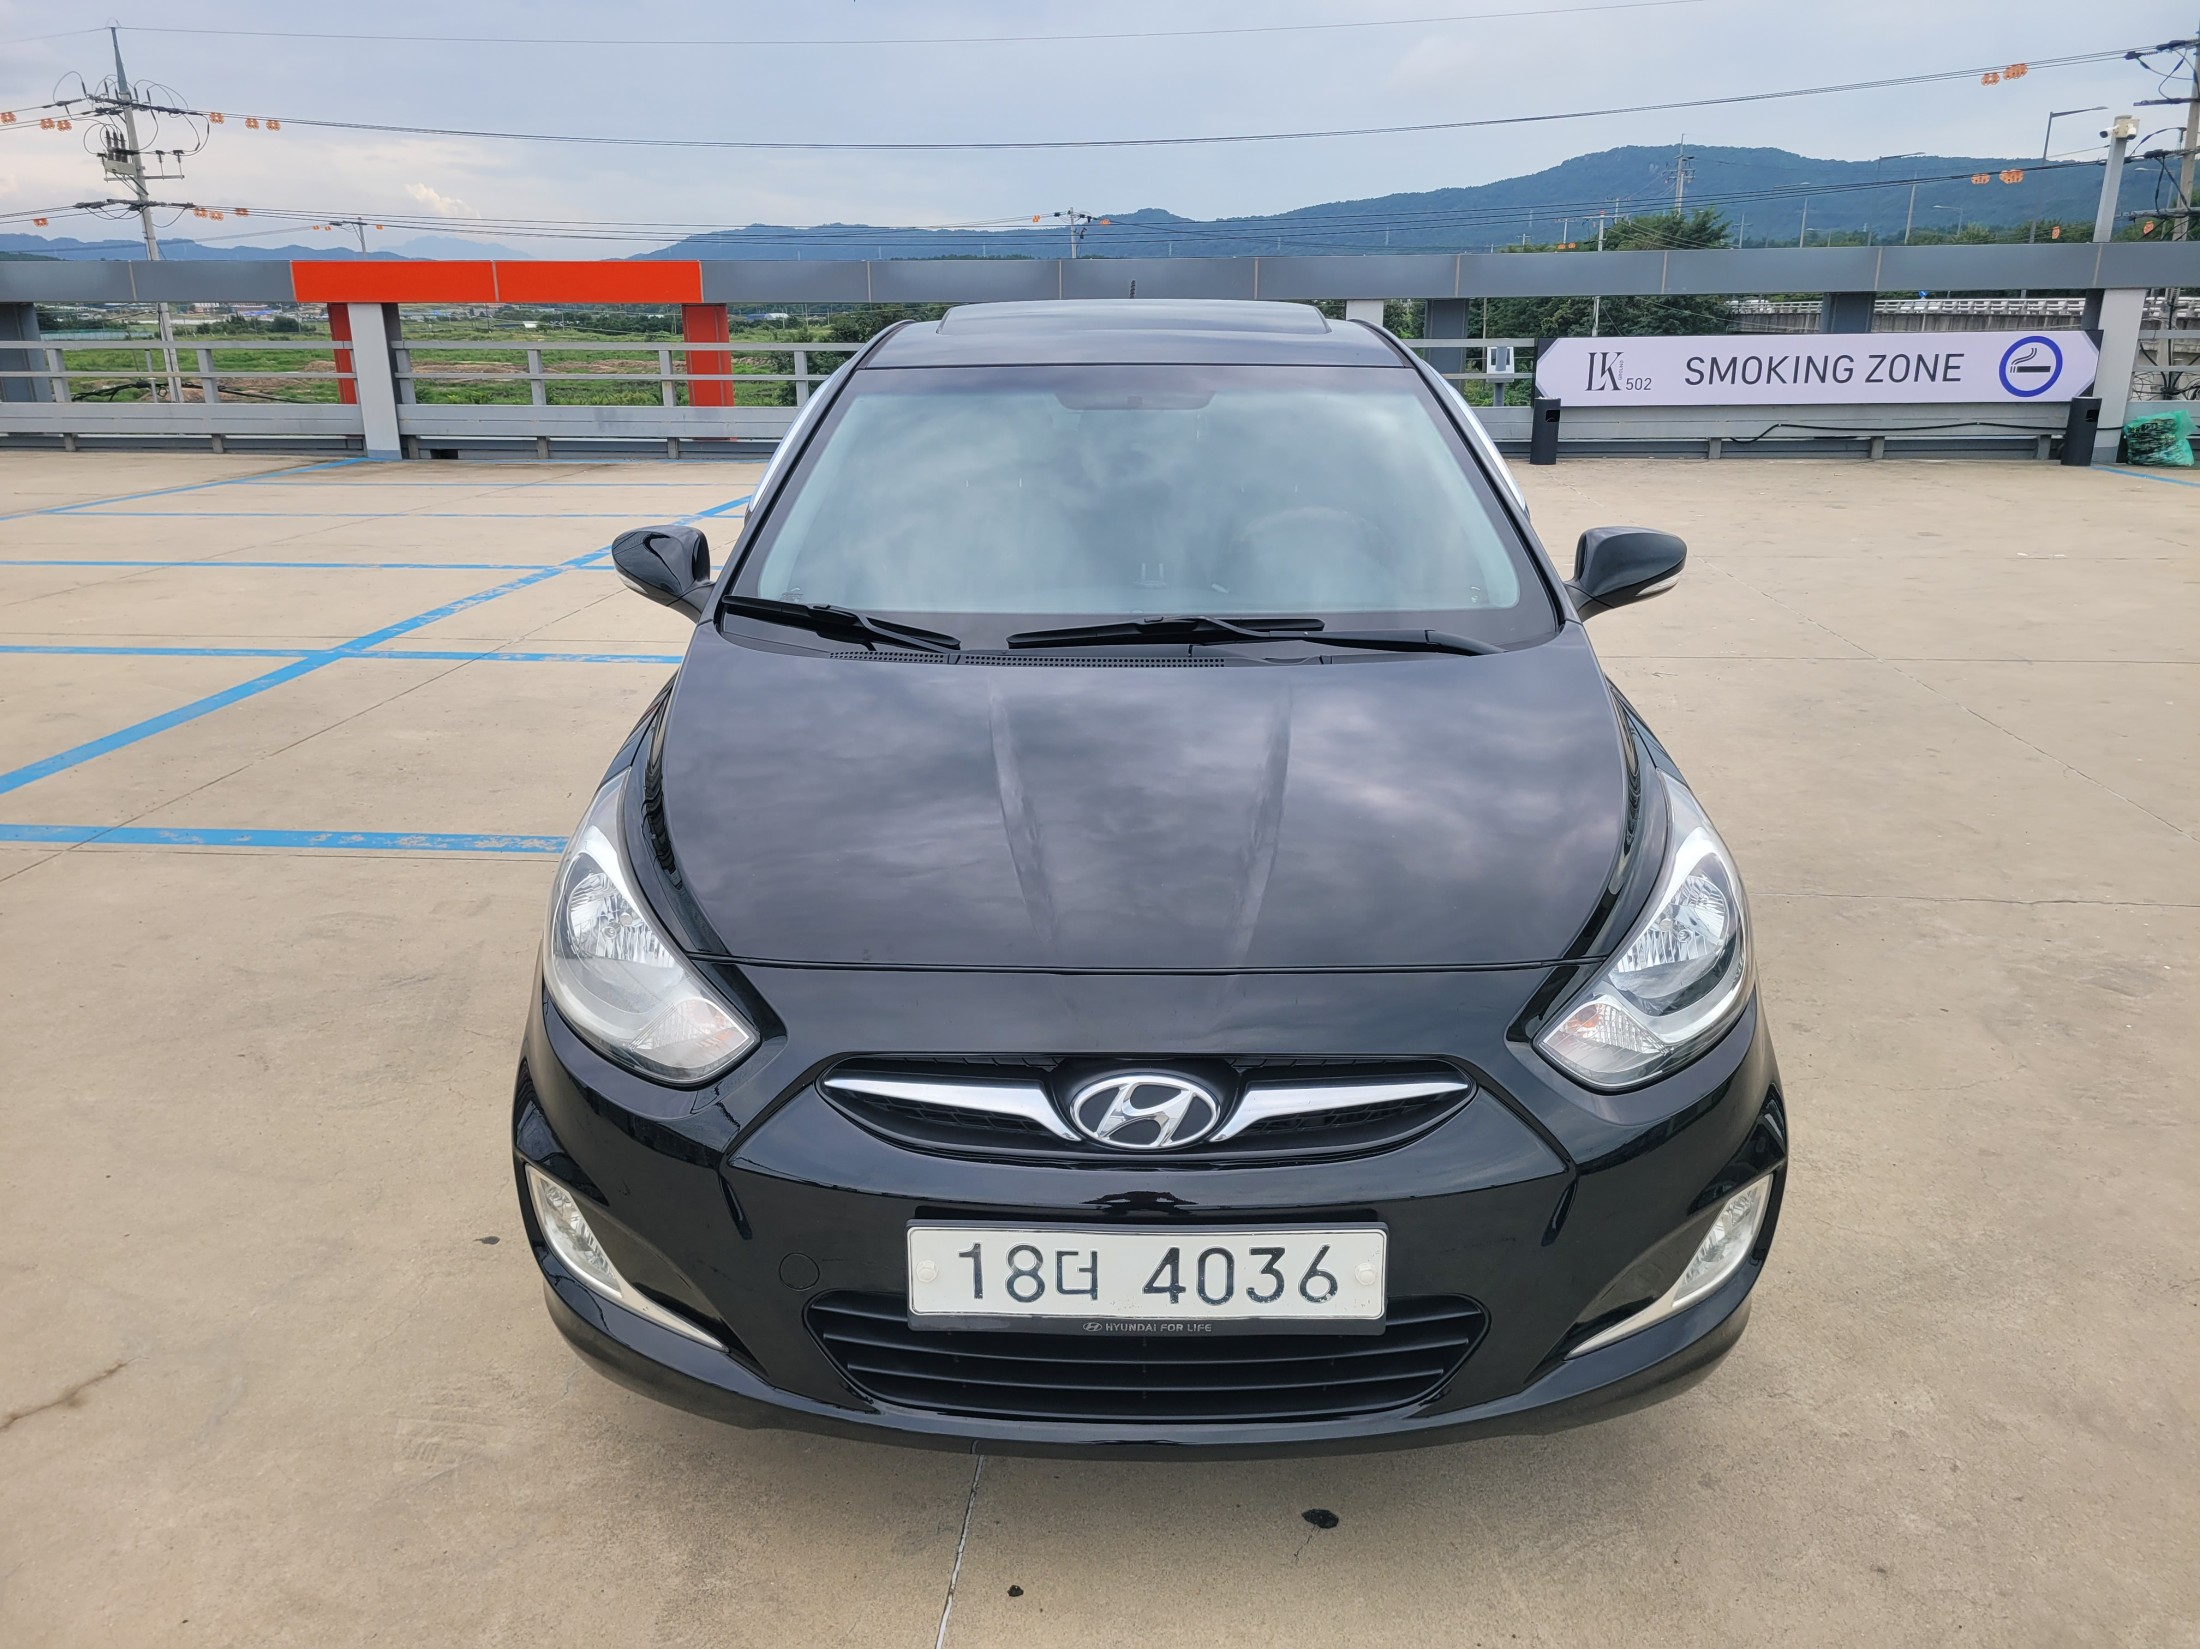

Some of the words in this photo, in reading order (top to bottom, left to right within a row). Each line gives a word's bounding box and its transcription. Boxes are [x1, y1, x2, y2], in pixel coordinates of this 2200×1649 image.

[1684, 355, 1855, 386] SMOKING
[1864, 353, 1965, 383] ZONE
[1626, 377, 1652, 391] 502
[958, 1242, 1099, 1304] 18더
[1142, 1244, 1339, 1306] 4036
[1105, 1323, 1157, 1332] HYUNDAI
[1160, 1323, 1184, 1332] FOR
[1187, 1323, 1212, 1332] LIFE
